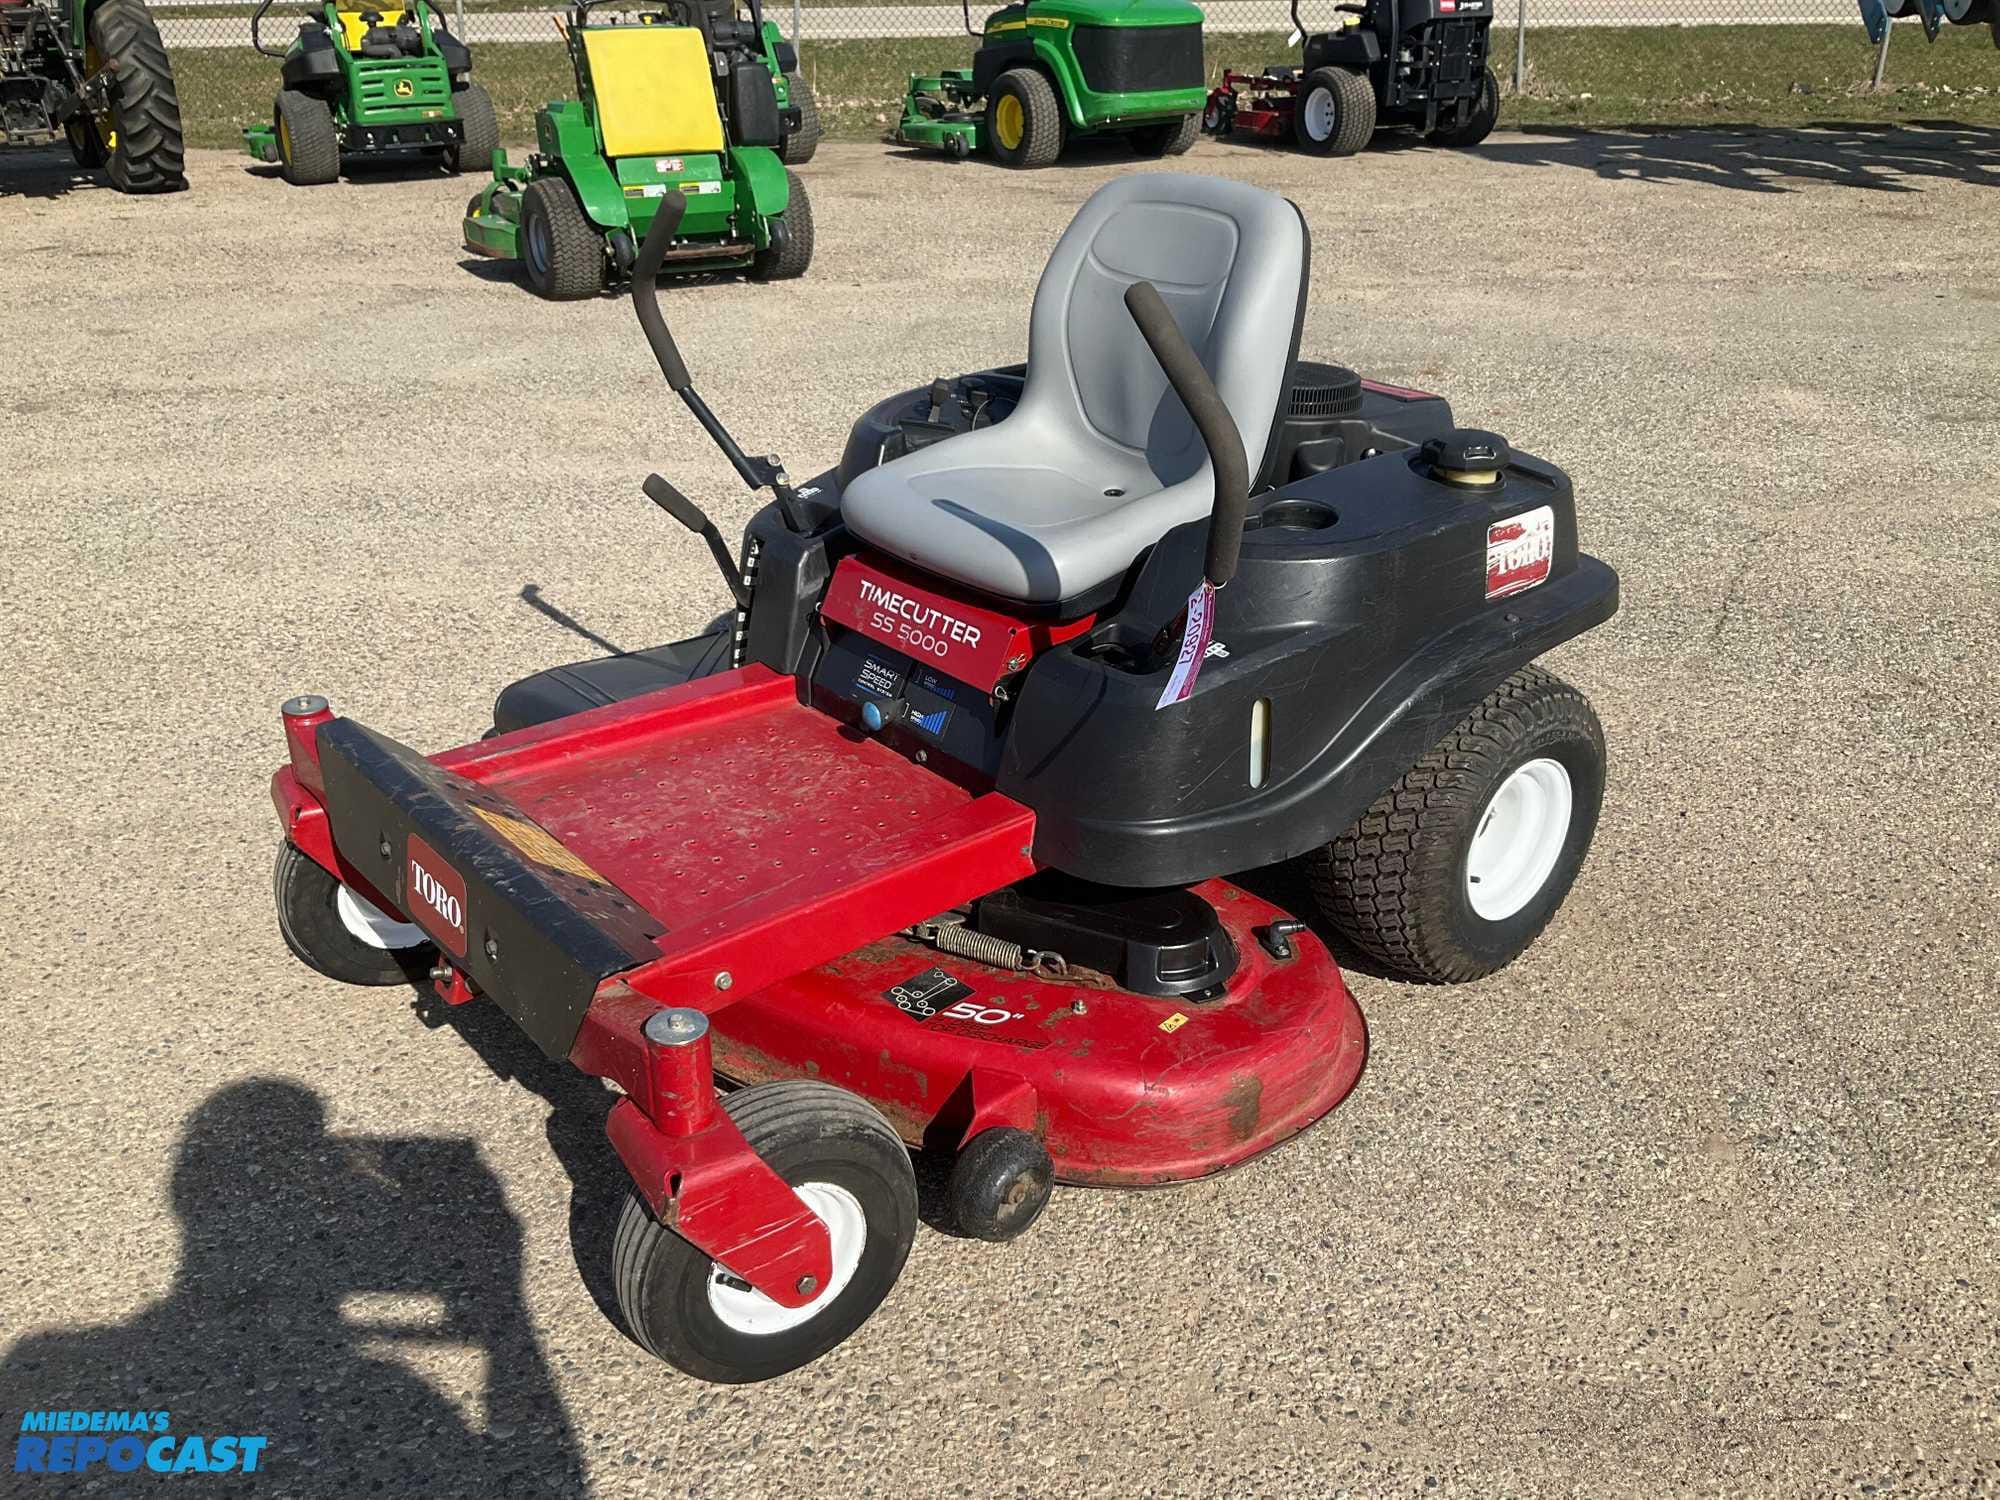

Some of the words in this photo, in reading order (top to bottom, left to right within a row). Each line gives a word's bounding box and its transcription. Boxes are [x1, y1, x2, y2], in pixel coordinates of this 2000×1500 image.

[858, 578, 982, 649] TIMECUTTER
[870, 612, 894, 633] SS
[900, 622, 948, 657] 5000
[860, 669, 892, 690] SPEED
[864, 659, 900, 681] SMART
[411, 859, 462, 928] TORO
[942, 1002, 1025, 1024] 50"
